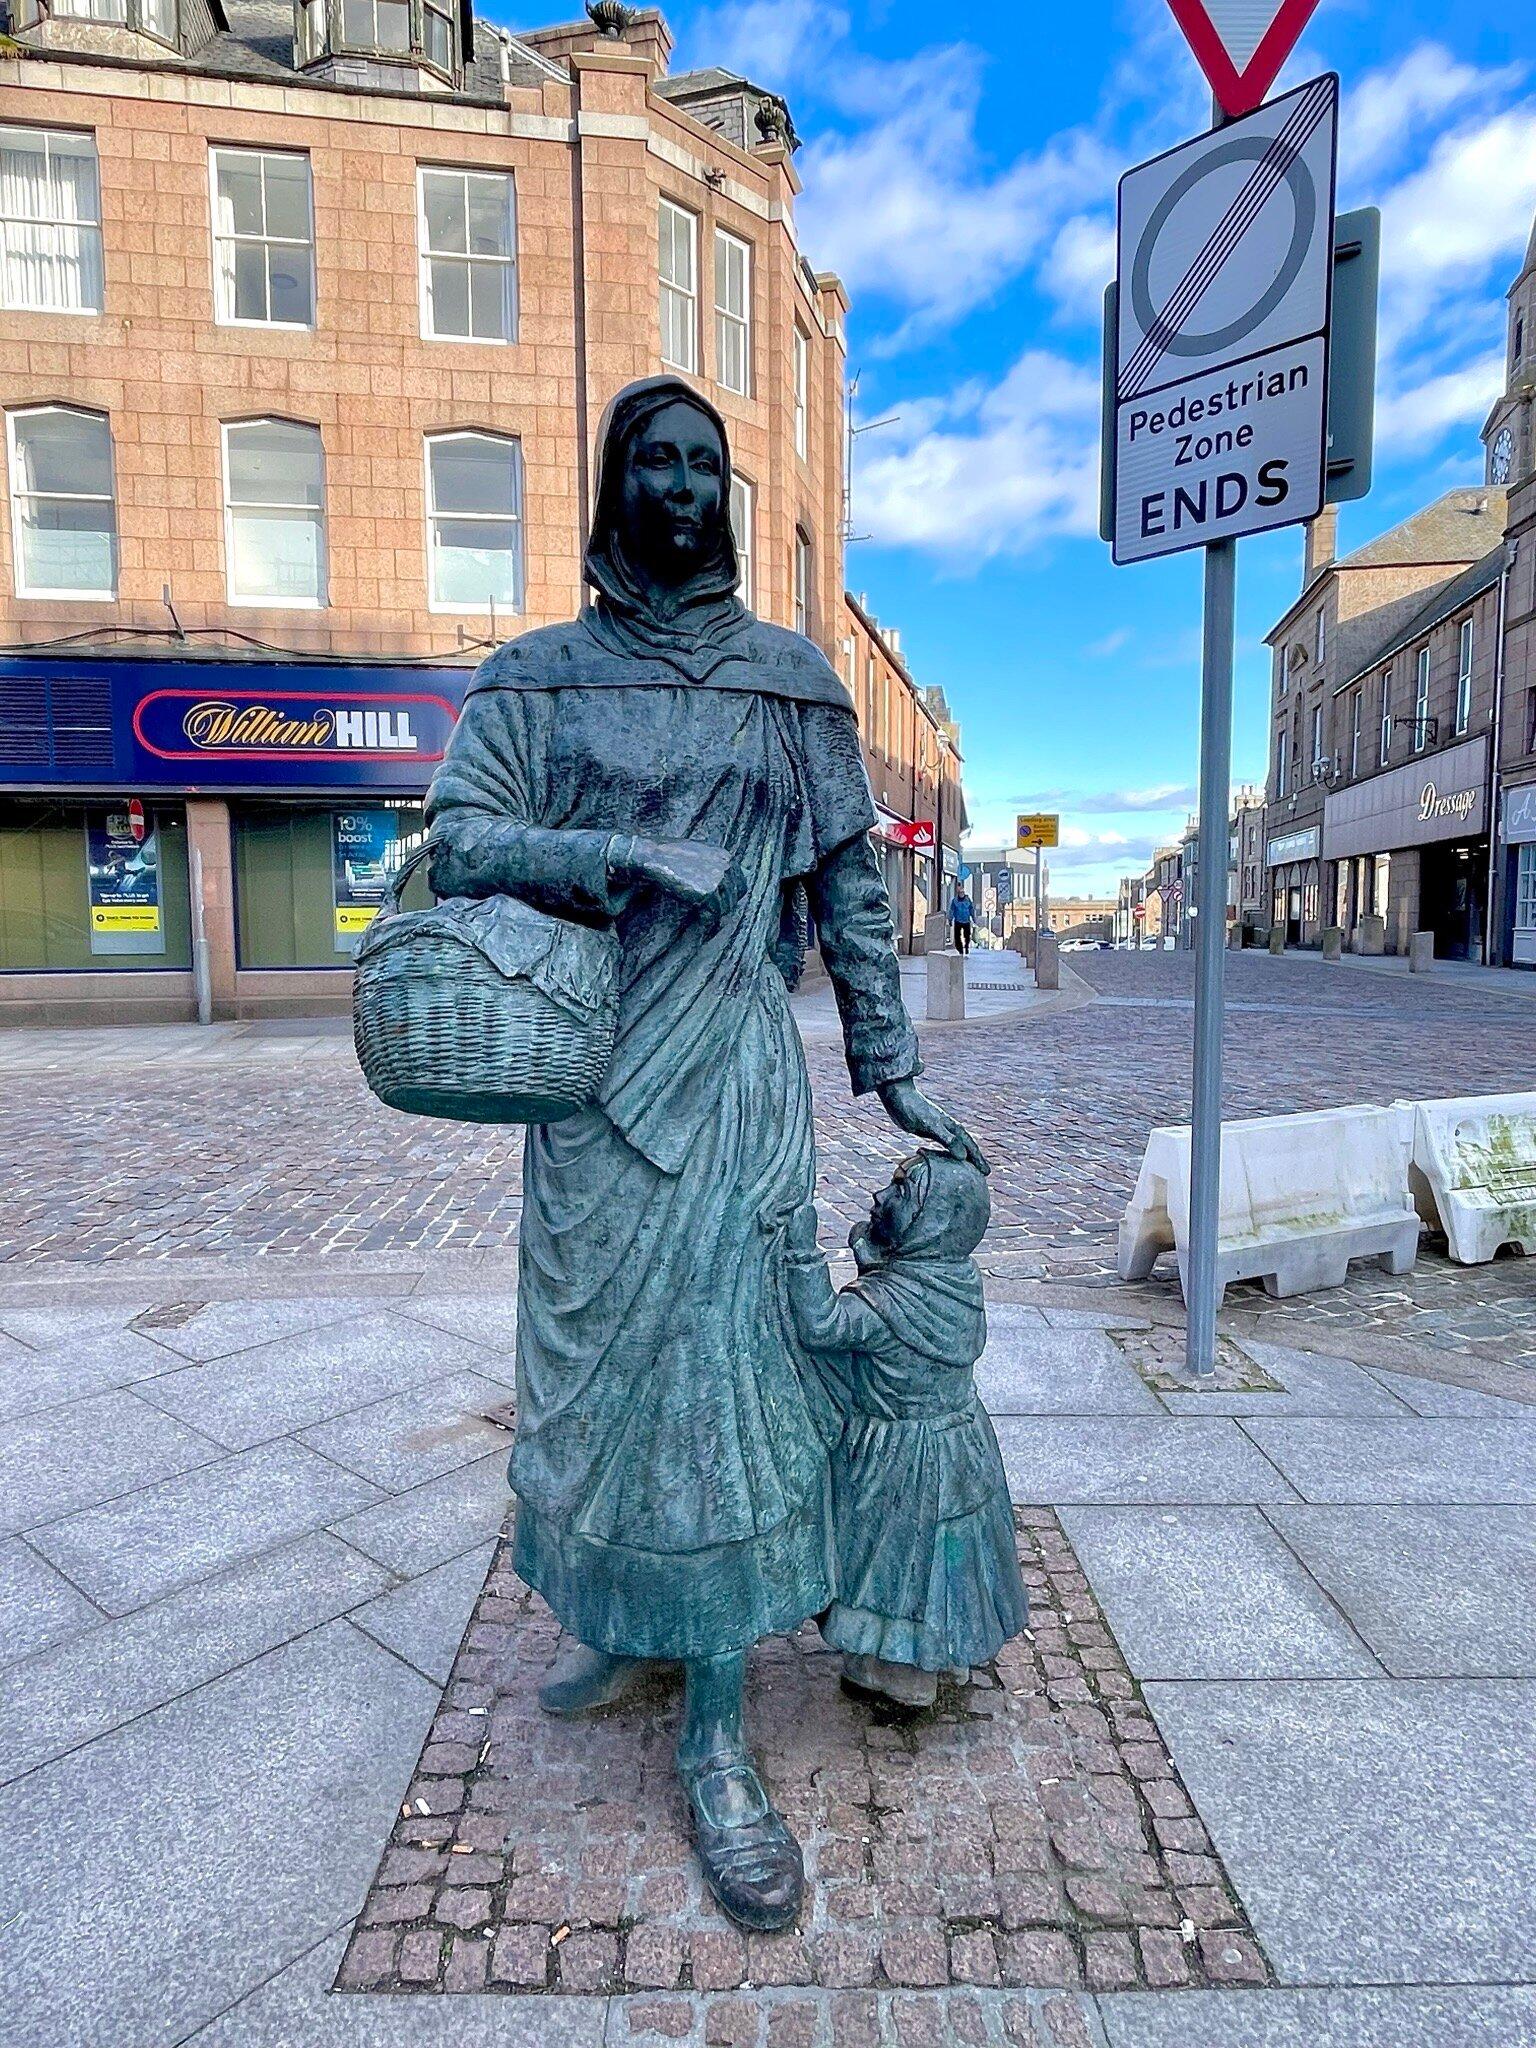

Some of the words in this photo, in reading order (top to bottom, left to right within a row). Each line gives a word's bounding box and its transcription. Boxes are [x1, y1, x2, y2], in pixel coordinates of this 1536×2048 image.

[1129, 364, 1309, 442] Pedestrian
[1174, 423, 1254, 467] Zone
[1140, 459, 1290, 539] ENDS
[183, 702, 336, 750] William
[336, 710, 418, 748] HILL
[1417, 781, 1476, 821] Dressage
[338, 816, 373, 831] 10%
[338, 832, 373, 843] boost
